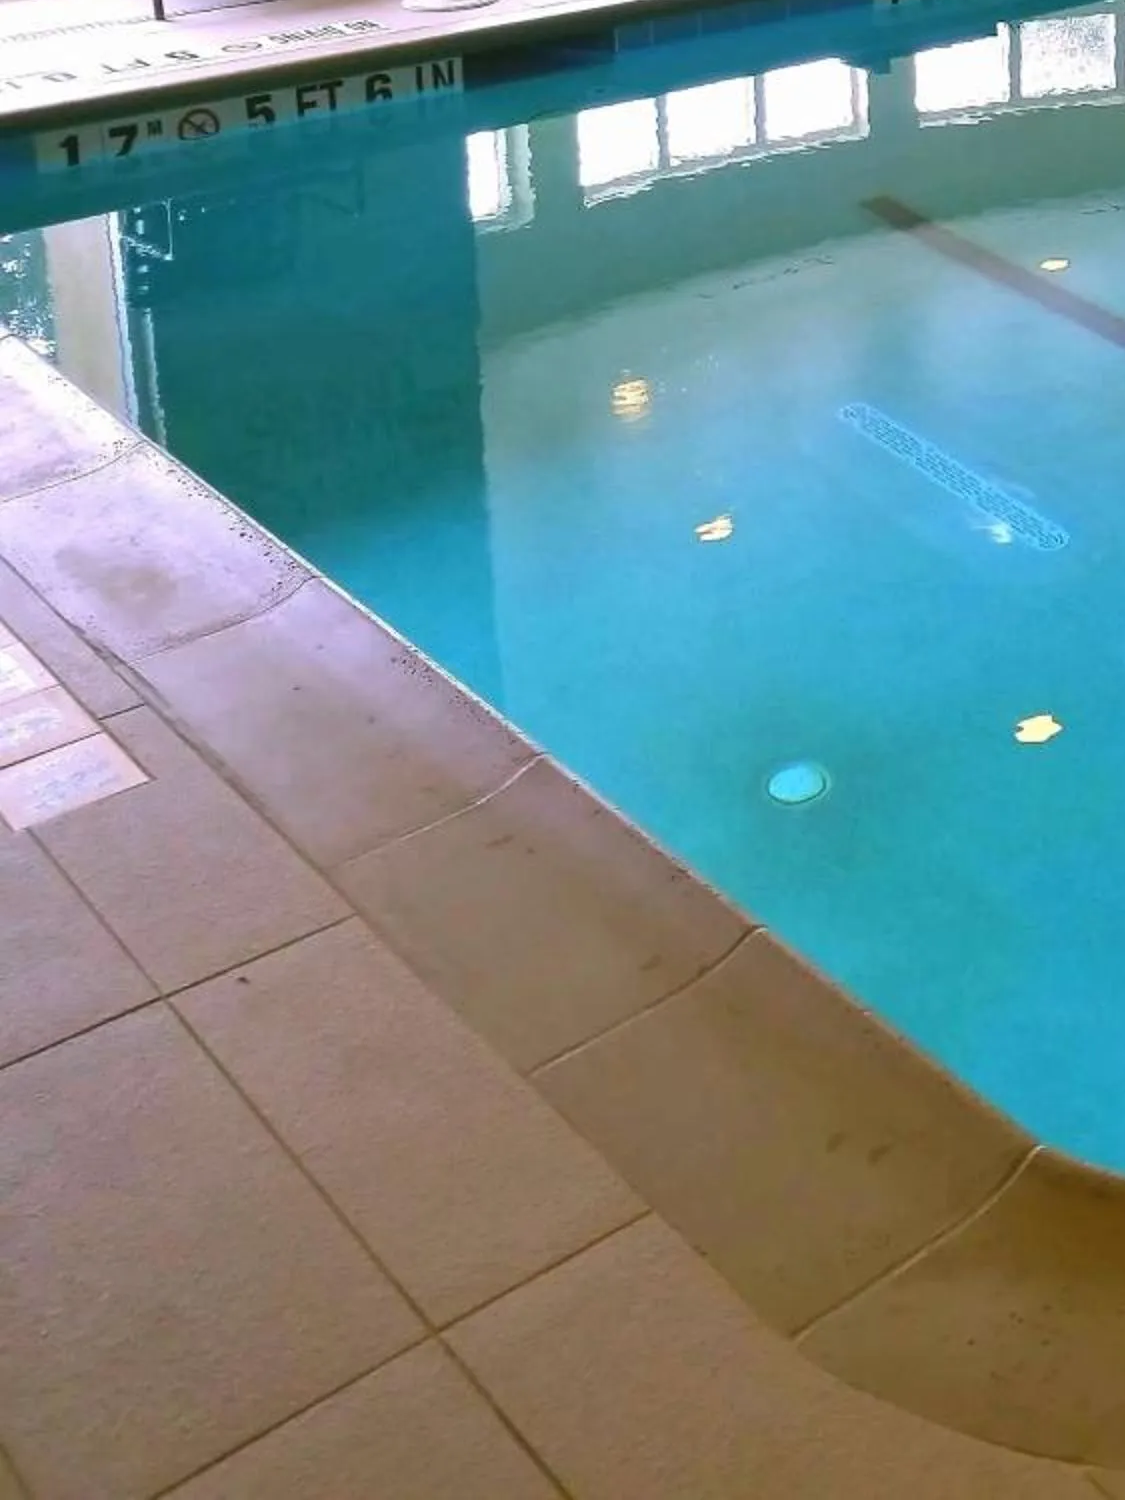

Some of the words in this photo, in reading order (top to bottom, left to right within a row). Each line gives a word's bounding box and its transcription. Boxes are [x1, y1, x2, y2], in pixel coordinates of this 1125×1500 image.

[245, 93, 276, 128] 5
[296, 79, 344, 117] FT
[415, 59, 455, 93] IN
